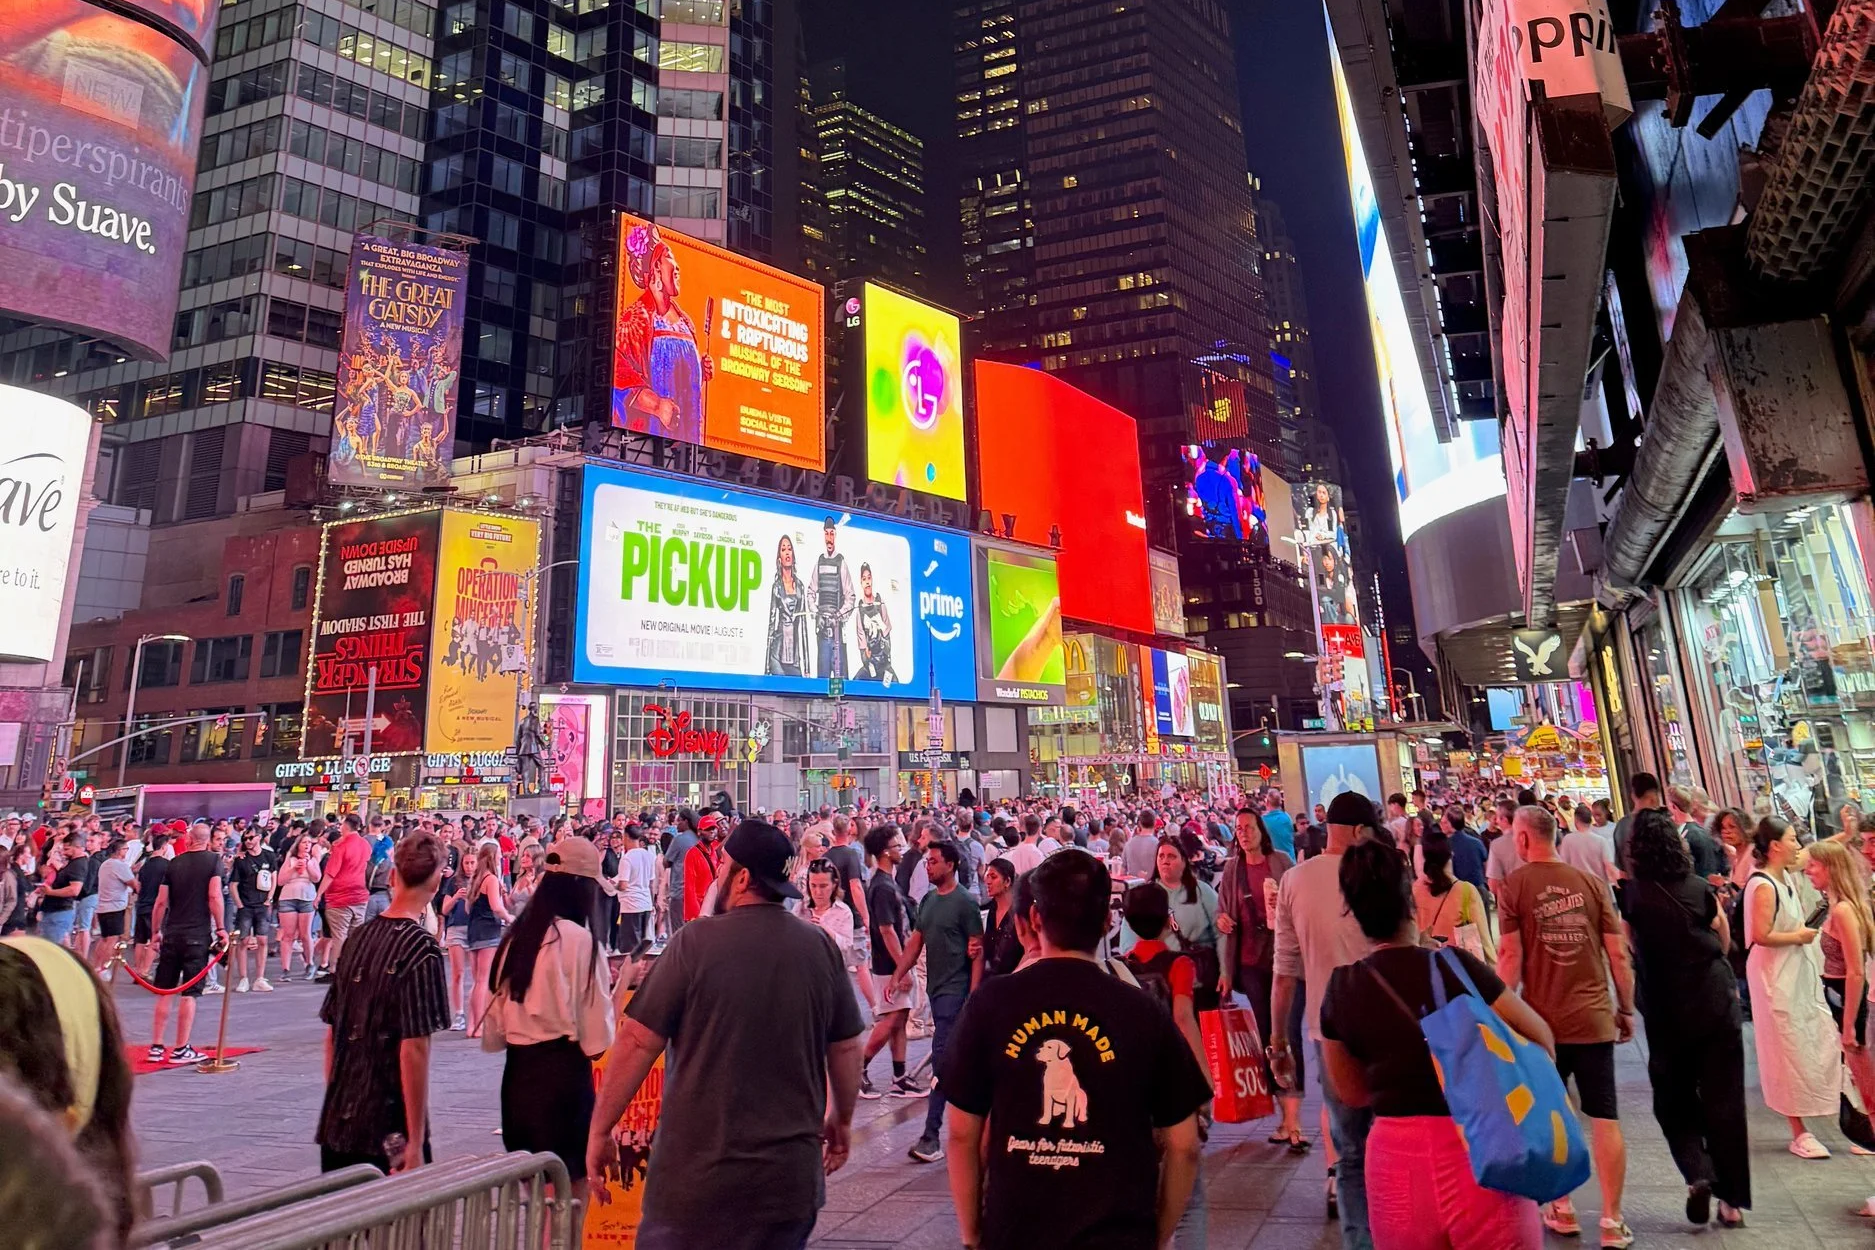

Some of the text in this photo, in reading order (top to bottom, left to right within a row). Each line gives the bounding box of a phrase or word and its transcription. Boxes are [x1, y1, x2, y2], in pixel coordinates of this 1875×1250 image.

[72, 74, 134, 112] NEW
[48, 182, 156, 255] Suave.
[375, 262, 402, 272] EXPLODES
[380, 254, 443, 273] EXTRAVAGANZA
[401, 249, 416, 259] BIG
[416, 253, 460, 268] BROADWAY
[360, 273, 456, 310] THE GREAT
[368, 298, 444, 329] GATSBY
[764, 297, 790, 317] MOST
[386, 323, 401, 331] NEW
[402, 325, 430, 336] MUSICAL
[721, 298, 809, 343] INTOXICATING
[847, 317, 860, 327] LG
[721, 319, 809, 363] & RAPTUROUS
[721, 357, 770, 383] BROADWAY
[729, 343, 802, 376] MUSICAL OF THE
[740, 416, 769, 431] SOCIAL
[637, 519, 662, 534] THE
[712, 511, 737, 521] DANGEROUS
[341, 536, 418, 560] UPSIDE DOWN
[343, 553, 412, 574] HAS TURNED
[621, 530, 762, 612] PICKUP
[14, 568, 27, 587] to
[343, 569, 409, 590] BROADWAY
[456, 567, 518, 601] OPERATION
[1253, 569, 1263, 606] 1500
[919, 588, 964, 620] prime
[320, 611, 426, 636] THE FIRST SHADOW
[640, 620, 656, 631] NEW
[658, 621, 689, 633] ORIGINAL
[690, 624, 710, 636] MOVIE
[714, 627, 739, 637] AUGUST
[335, 632, 407, 661] THINGS
[995, 688, 1049, 701] Wonderful PISTACHIOS
[643, 704, 730, 771] Disney
[275, 757, 391, 778] GIFTS LUGGGE
[427, 754, 461, 768] GIFTS
[1004, 1010, 1116, 1063] HUMAN MADE
[1007, 1135, 1105, 1154] Gears for futuristic
[1028, 1151, 1080, 1170] teenagers
